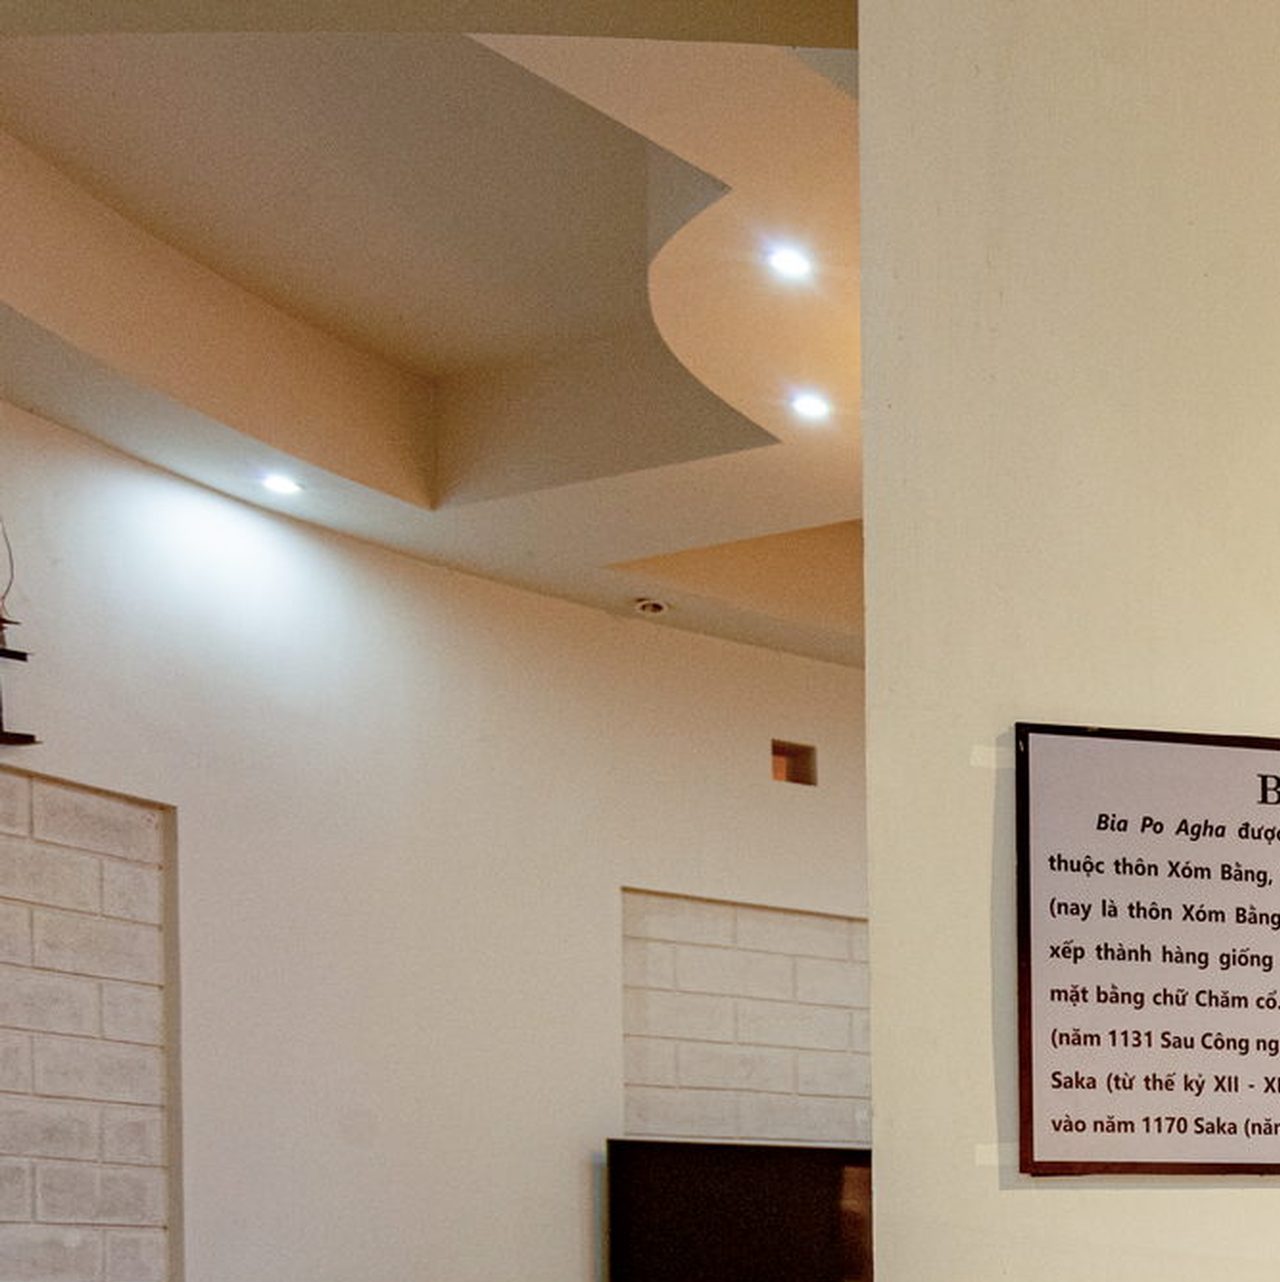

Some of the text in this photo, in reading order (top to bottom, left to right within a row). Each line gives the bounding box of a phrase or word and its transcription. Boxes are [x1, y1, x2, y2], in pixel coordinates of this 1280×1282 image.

[1096, 813, 1128, 832] Bia
[1140, 816, 1164, 834] Po
[1175, 819, 1226, 841] Agha
[1048, 853, 1104, 877] thuộc
[1113, 857, 1158, 876] thôn
[1167, 860, 1211, 880] Xóm
[1221, 862, 1272, 888] Bằng,
[1050, 897, 1092, 922] (nay
[1102, 899, 1118, 918] là
[1127, 901, 1172, 920] thôn
[1182, 904, 1225, 923] Xóm
[1050, 940, 1085, 964] xếp
[1095, 942, 1151, 962] thành
[1162, 945, 1209, 970] hàng
[1219, 948, 1273, 972] giống
[1050, 985, 1089, 1007] mặt
[1096, 984, 1145, 1010] bằng
[1153, 988, 1189, 1006] chữ
[1195, 989, 1248, 1008] Chăm
[1051, 1028, 1101, 1049] (năm
[1109, 1030, 1152, 1048] 1131
[1161, 1031, 1194, 1049] Sau
[1201, 1032, 1249, 1056] Công
[1051, 1071, 1096, 1089] Saka
[1107, 1072, 1135, 1094] (từ
[1143, 1072, 1176, 1091] thế
[1184, 1074, 1205, 1097] kỷ
[1214, 1075, 1238, 1093] XII
[1051, 1114, 1086, 1132] vào
[1093, 1115, 1135, 1133] năm
[1142, 1116, 1188, 1134] 1170
[1194, 1117, 1237, 1135] Saka
